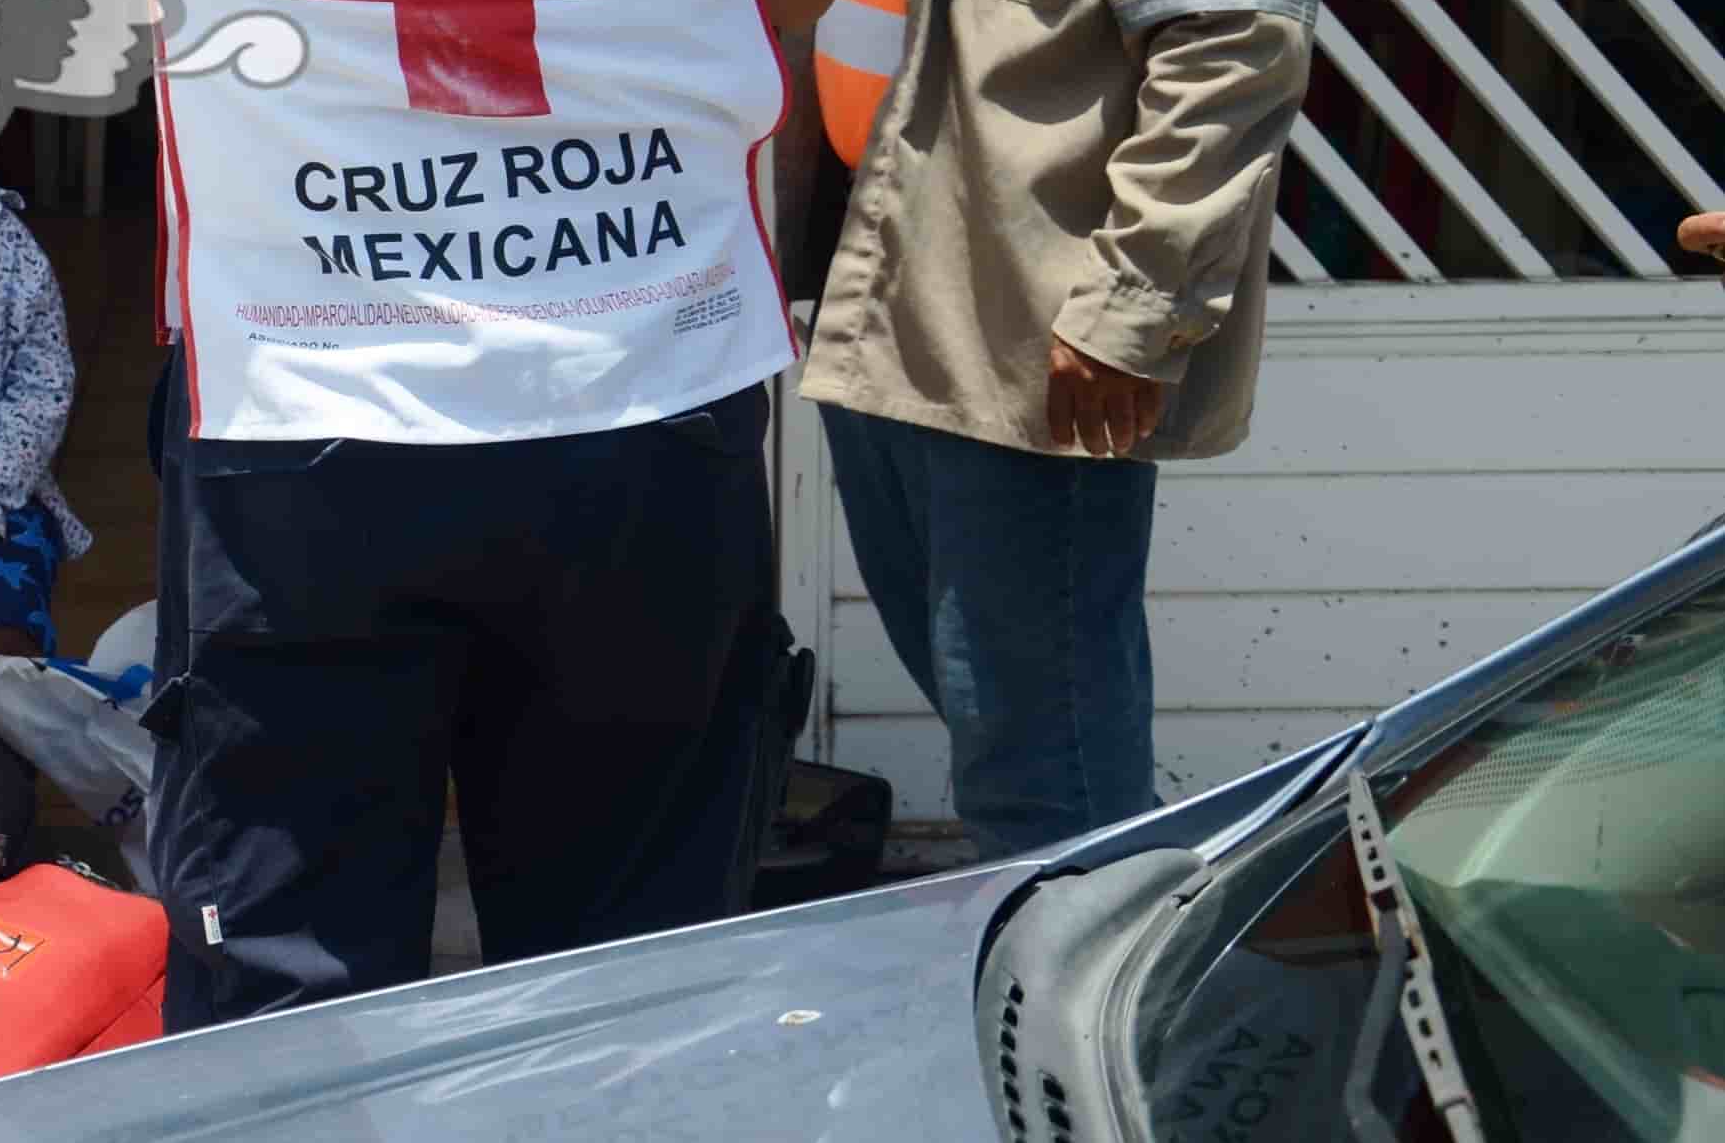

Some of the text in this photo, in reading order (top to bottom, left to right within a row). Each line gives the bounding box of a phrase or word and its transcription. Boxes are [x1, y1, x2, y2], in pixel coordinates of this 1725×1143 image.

[294, 127, 684, 213] CRUZ ROJA
[302, 199, 687, 282] MEXICANA
